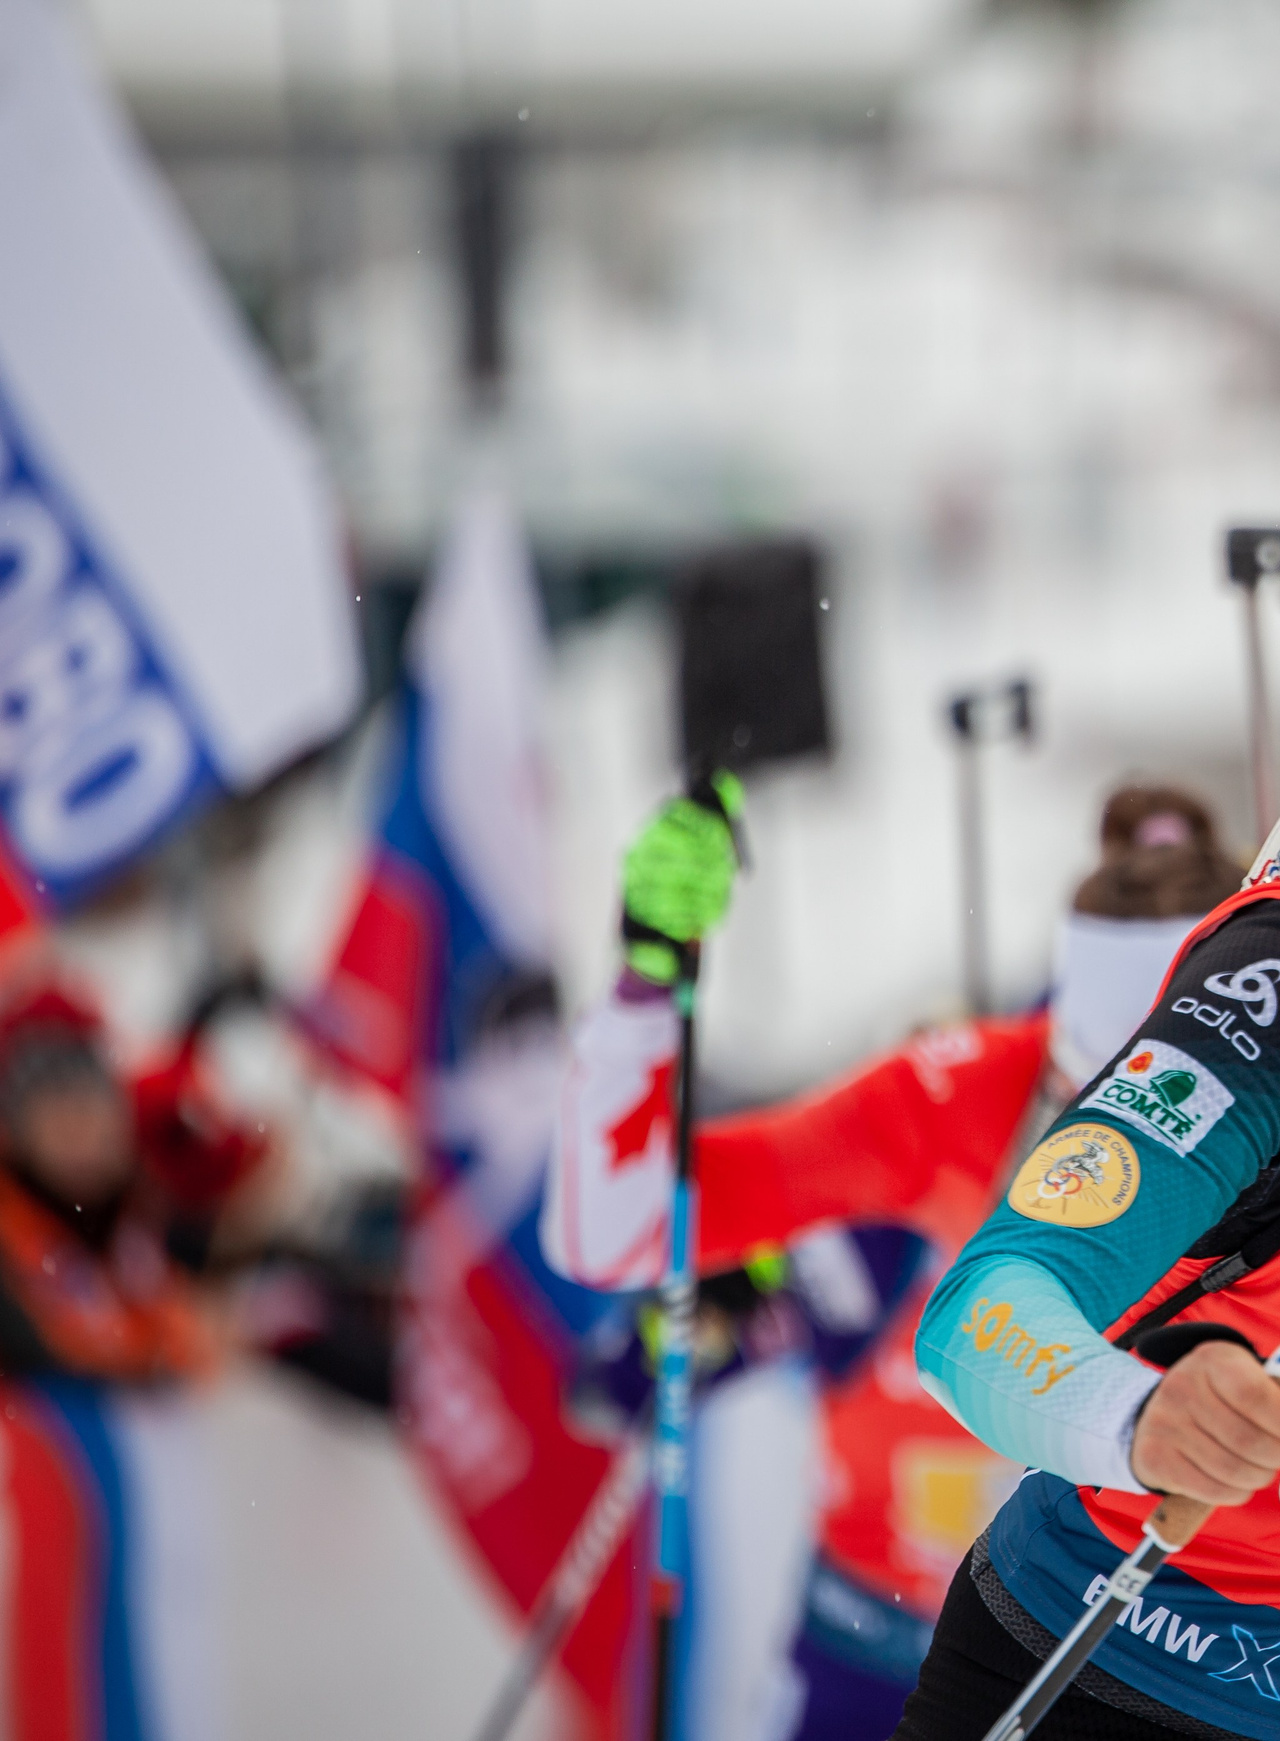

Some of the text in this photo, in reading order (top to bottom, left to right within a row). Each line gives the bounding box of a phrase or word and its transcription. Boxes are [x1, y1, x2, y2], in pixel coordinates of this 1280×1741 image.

[1171, 996, 1261, 1061] odlo
[1092, 1131, 1112, 1143] DE
[1110, 1140, 1133, 1206] CHAMPIONS
